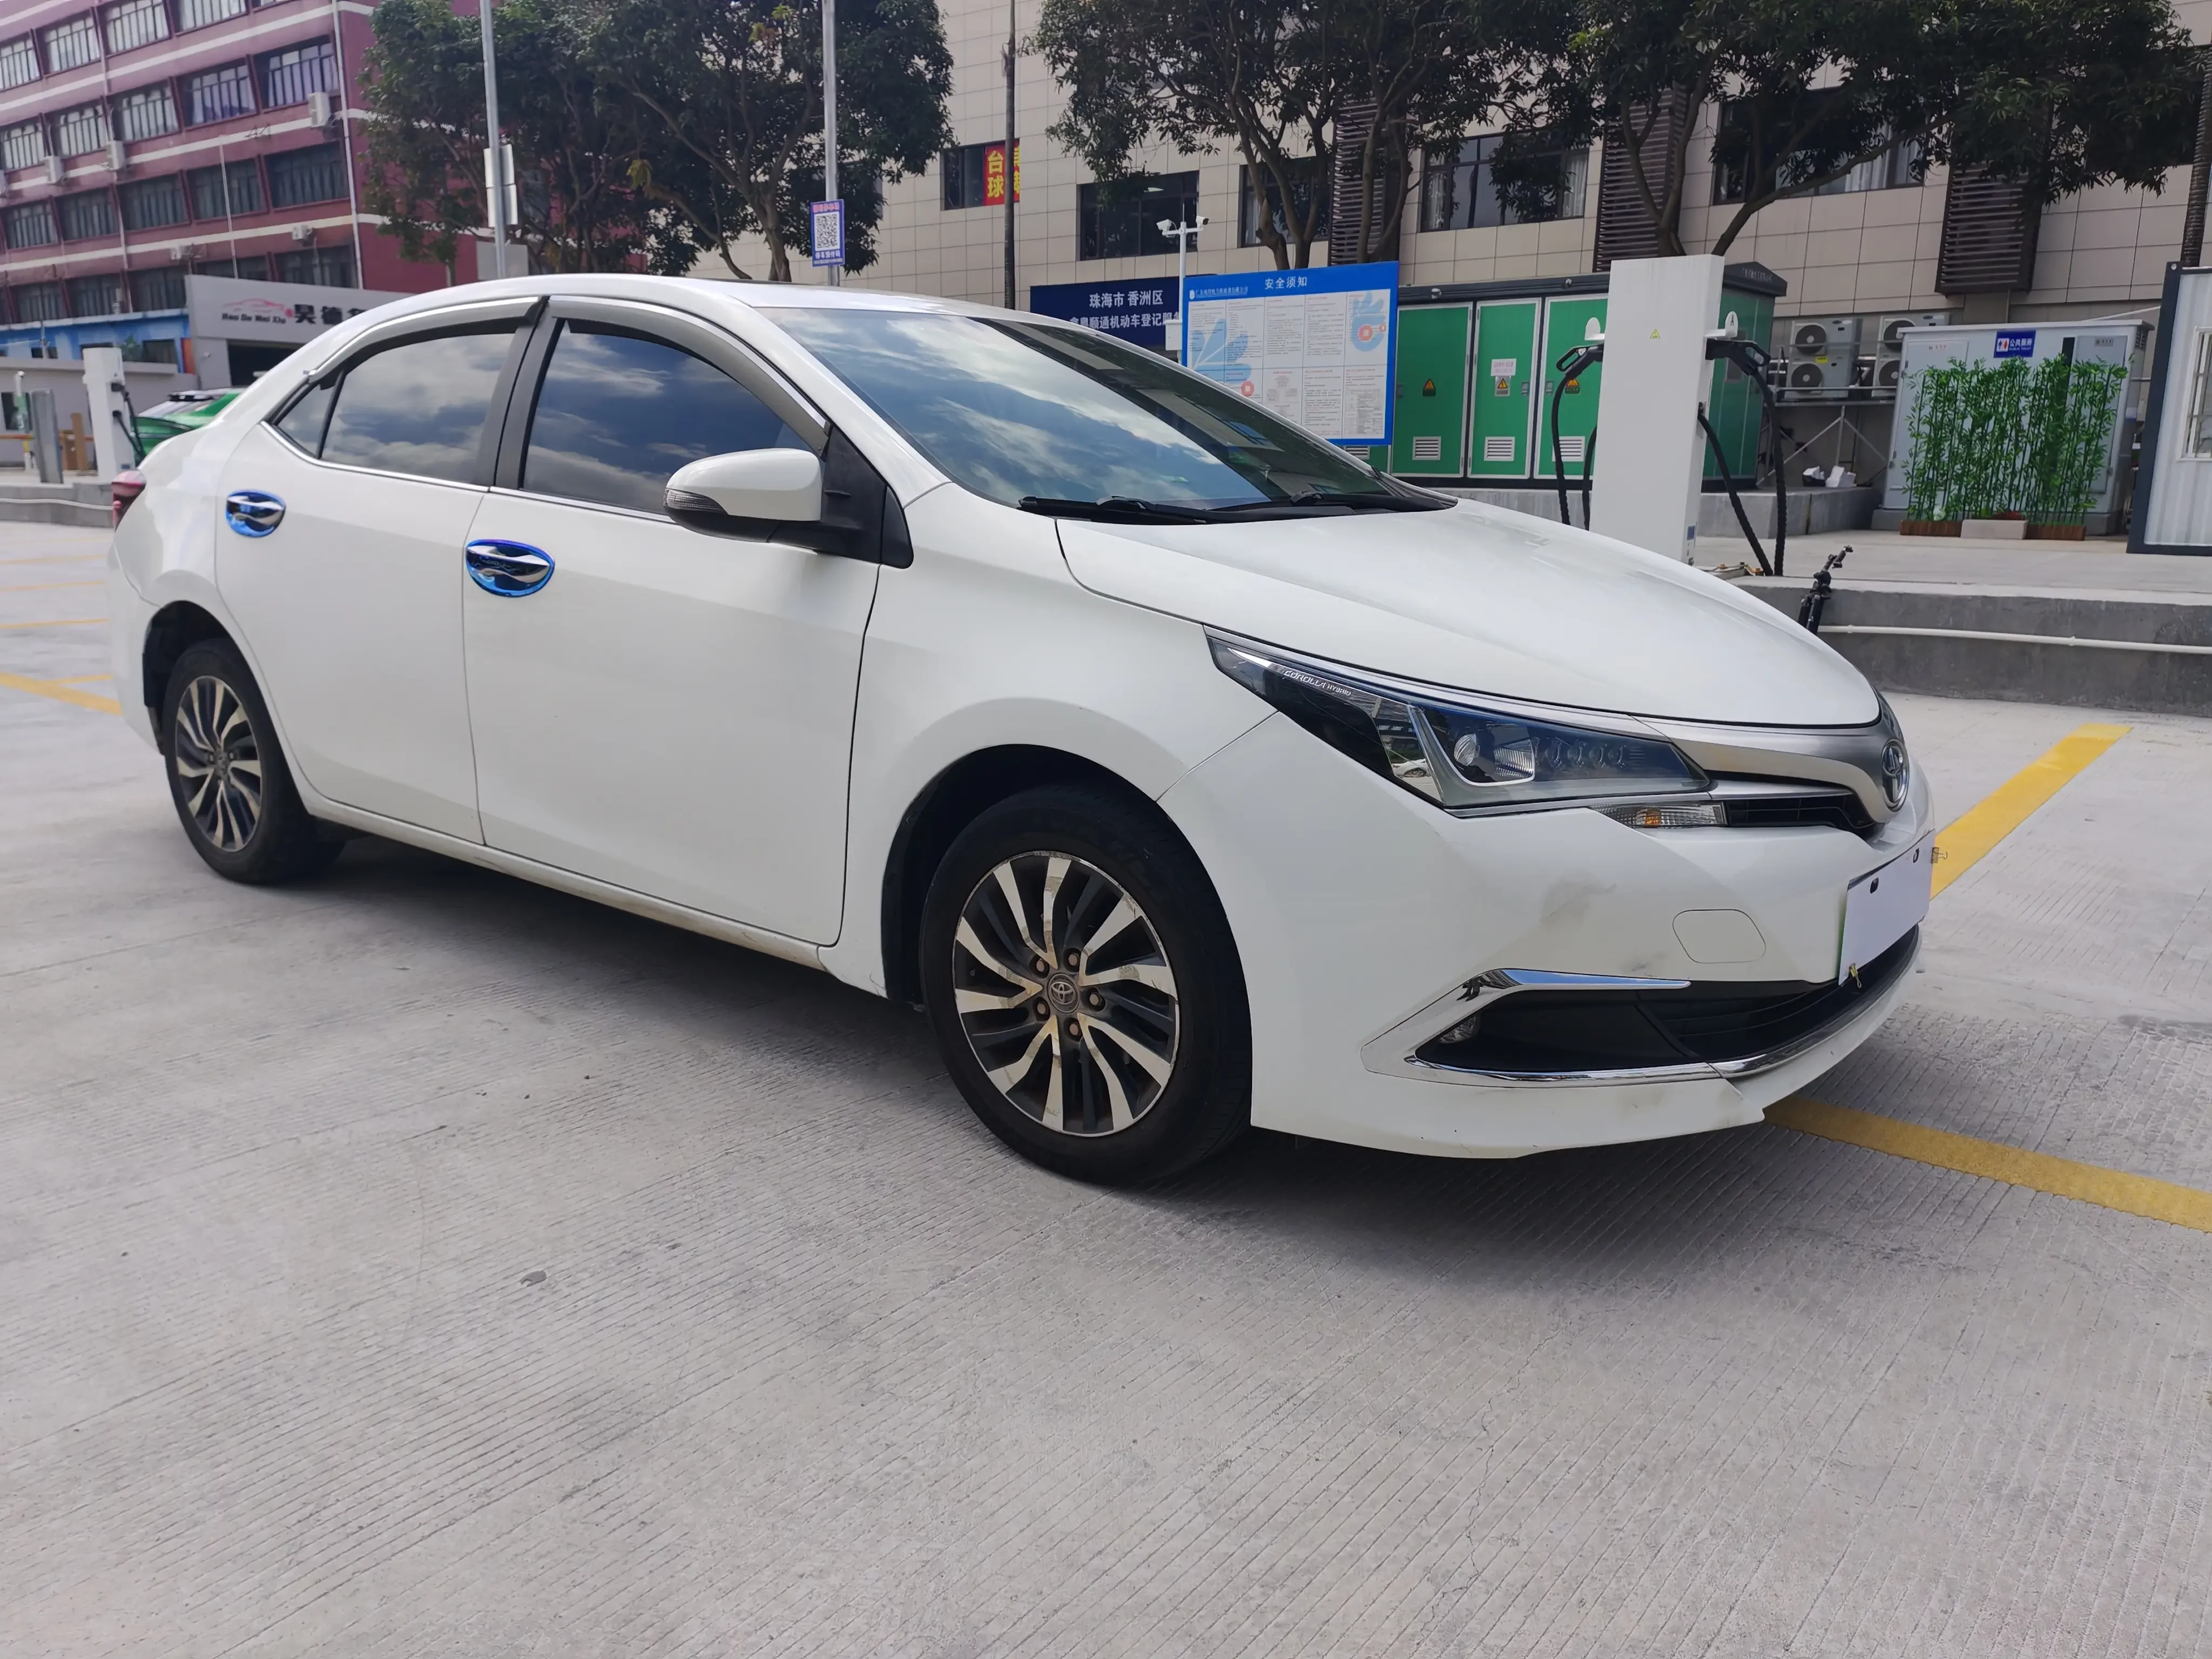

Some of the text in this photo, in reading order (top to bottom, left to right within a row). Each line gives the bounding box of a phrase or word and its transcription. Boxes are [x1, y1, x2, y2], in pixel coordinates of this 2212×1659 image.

[987, 150, 1004, 198] 台球
[1265, 275, 1308, 290] 安全须知
[1089, 289, 1164, 309] 珠海市 香洲区
[1283, 670, 1351, 696] COROLLA HYBRID
